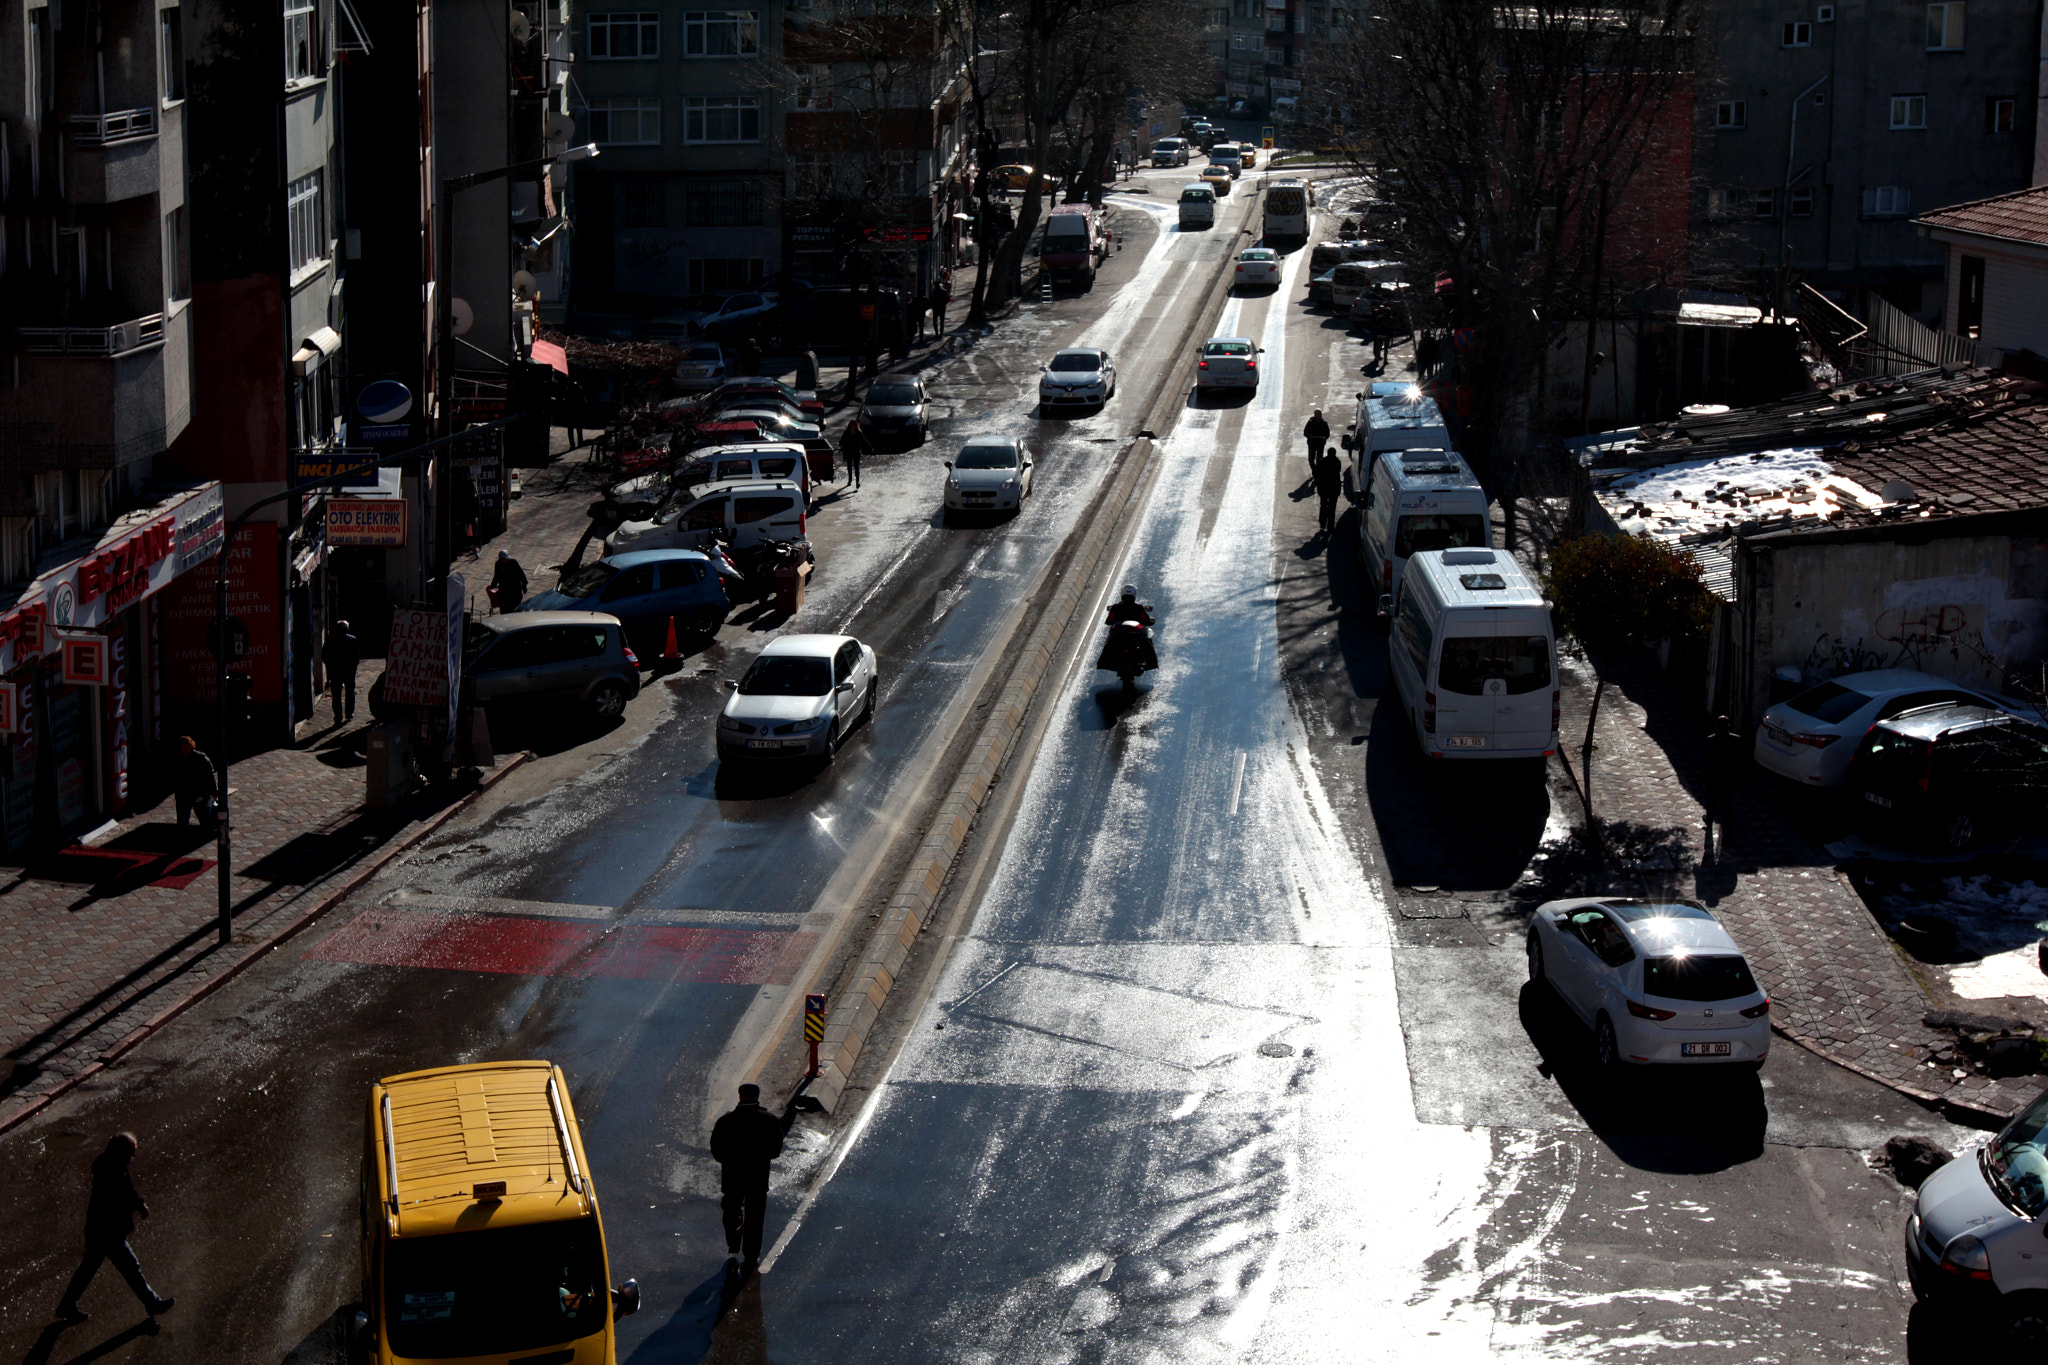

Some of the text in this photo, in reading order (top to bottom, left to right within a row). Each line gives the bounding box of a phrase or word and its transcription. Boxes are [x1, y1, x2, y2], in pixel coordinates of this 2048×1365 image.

[298, 459, 333, 477] İNCİ
[329, 511, 353, 525] OTO
[79, 515, 176, 604] ECZANE
[74, 646, 96, 675] E
[111, 636, 129, 800] ECZANE
[1688, 1044, 1728, 1053] 21 DR 003
